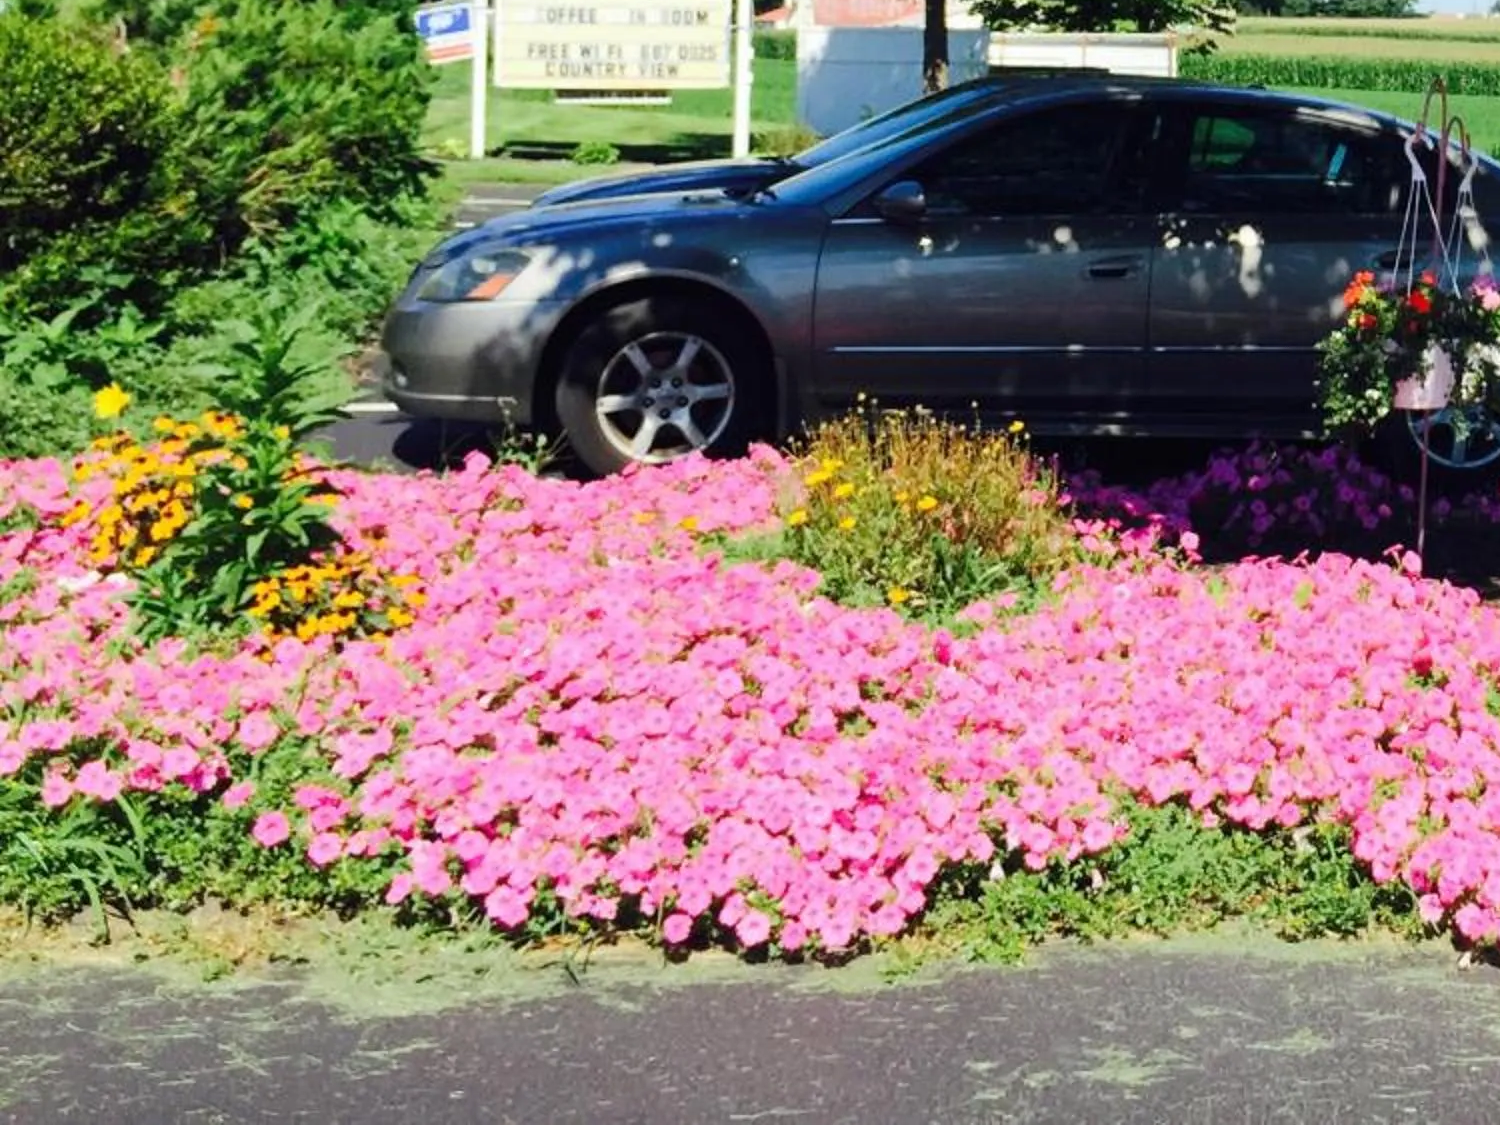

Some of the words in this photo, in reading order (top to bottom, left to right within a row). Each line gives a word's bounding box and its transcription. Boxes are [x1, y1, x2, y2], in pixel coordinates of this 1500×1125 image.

[527, 43, 569, 60] FREE
[545, 62, 627, 77] COUNTRY
[638, 63, 679, 77] VIEW
